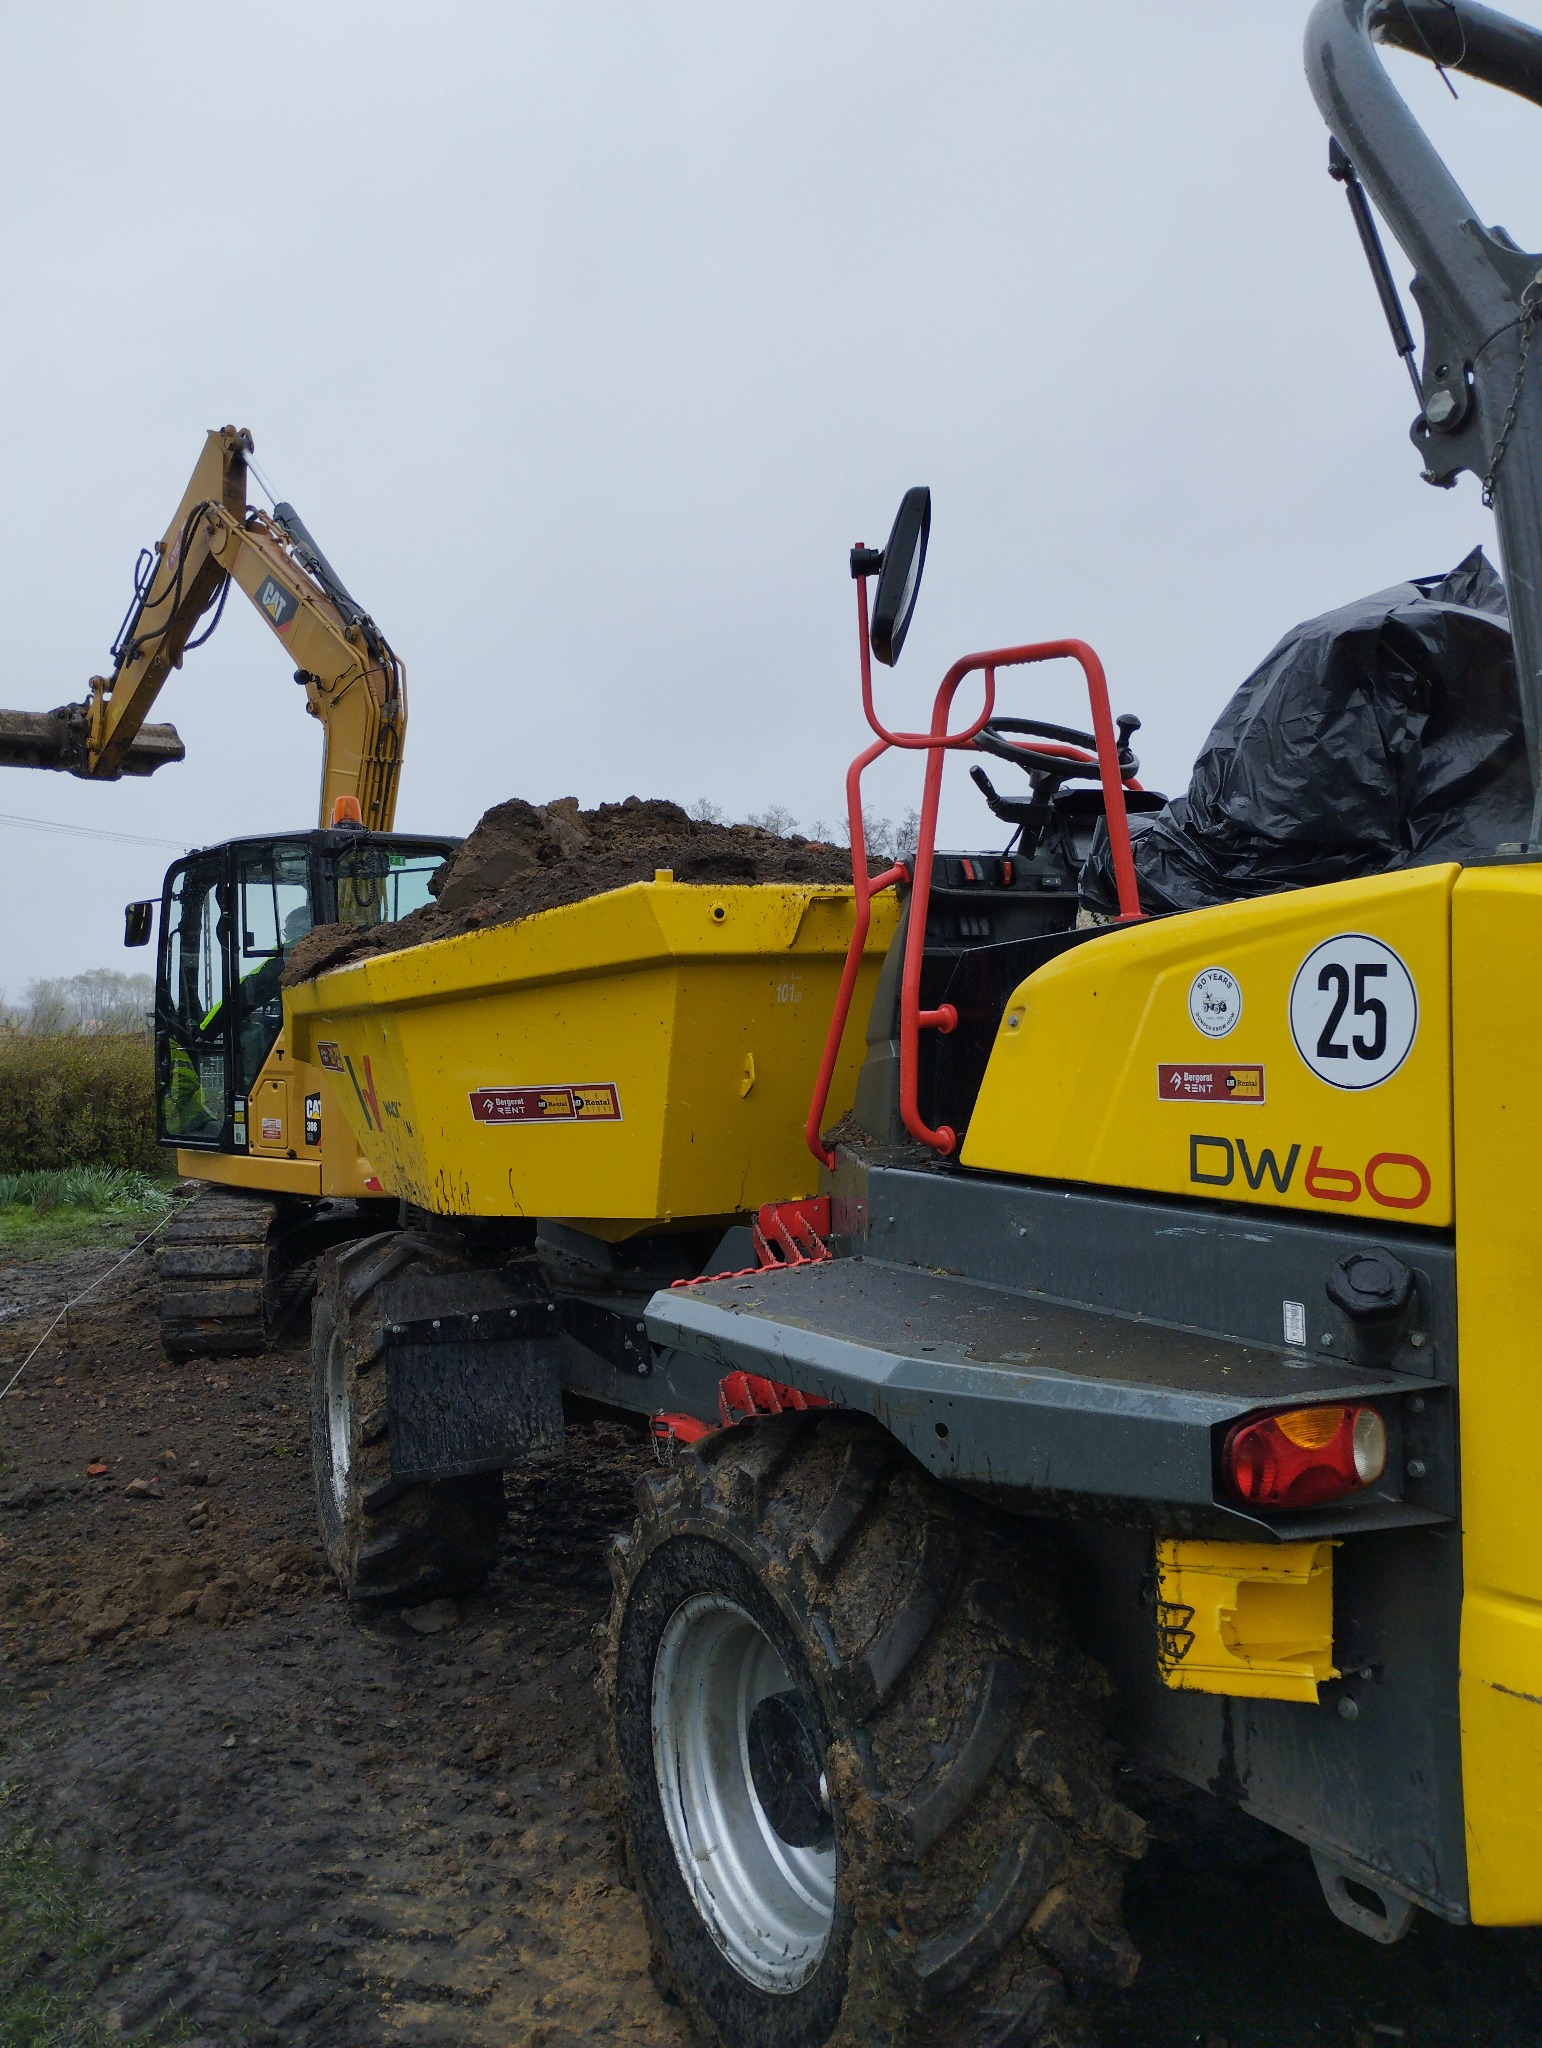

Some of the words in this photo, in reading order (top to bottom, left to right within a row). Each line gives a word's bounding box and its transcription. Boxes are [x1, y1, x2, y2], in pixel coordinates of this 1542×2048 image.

[262, 581, 286, 622] CAT
[1197, 978, 1207, 989] 50
[1207, 973, 1232, 989] YEARS
[1316, 963, 1388, 1061] 25
[1184, 1084, 1213, 1093] RENT
[1237, 1079, 1258, 1087] Rental
[1190, 1134, 1431, 1210] DW60
